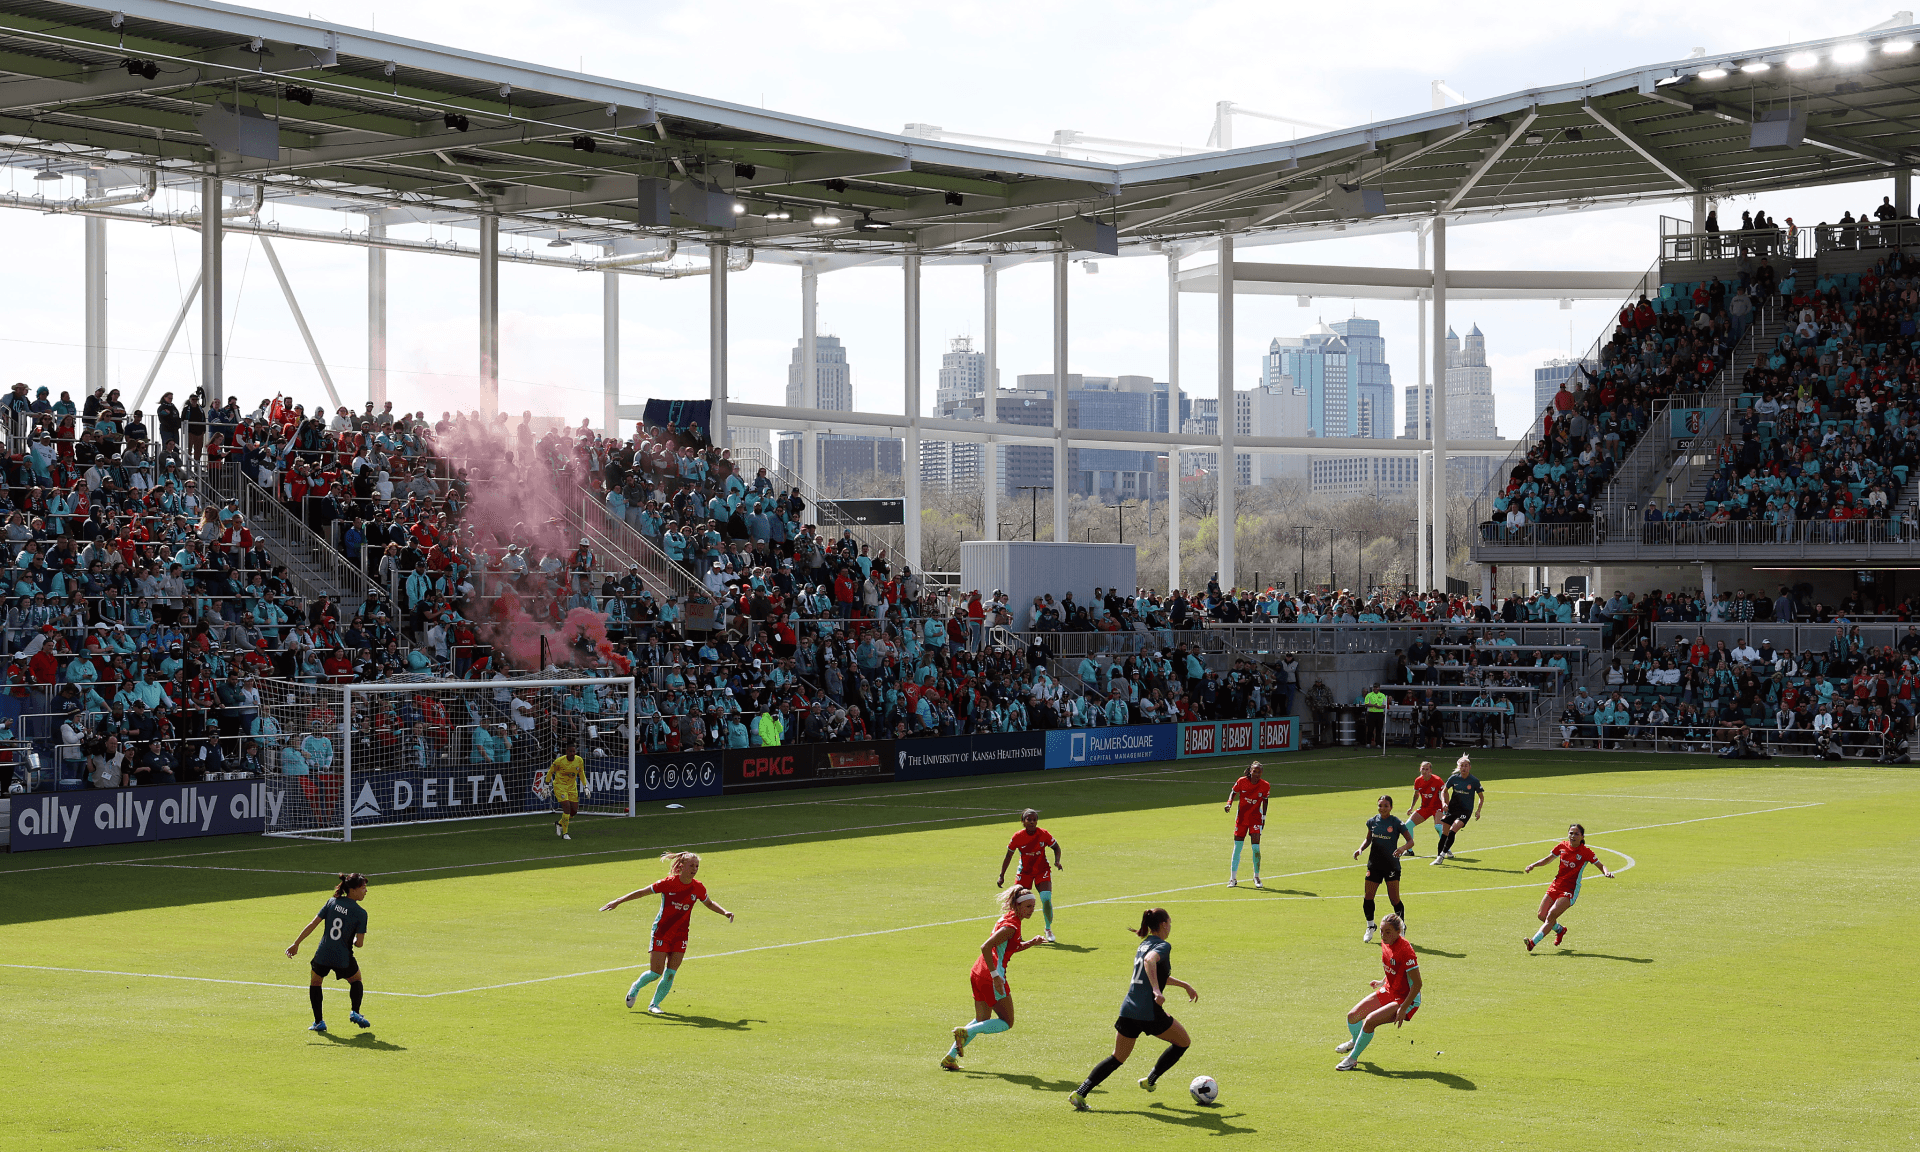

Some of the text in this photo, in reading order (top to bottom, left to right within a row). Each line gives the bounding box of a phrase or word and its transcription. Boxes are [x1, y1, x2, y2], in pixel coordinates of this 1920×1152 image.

[1192, 728, 1214, 751] BABY
[1229, 726, 1252, 748] BABY
[1267, 724, 1289, 746] BABY
[743, 756, 794, 777] CPKC
[908, 747, 1043, 766] THE UNIVERSITY OF KANSAS HEALTH SYSTEM
[1089, 751, 1152, 762] CAPITAL MANAGEMENT
[393, 774, 508, 811] DELTA
[18, 783, 286, 842] ally ally ally ally
[330, 917, 343, 941] 8
